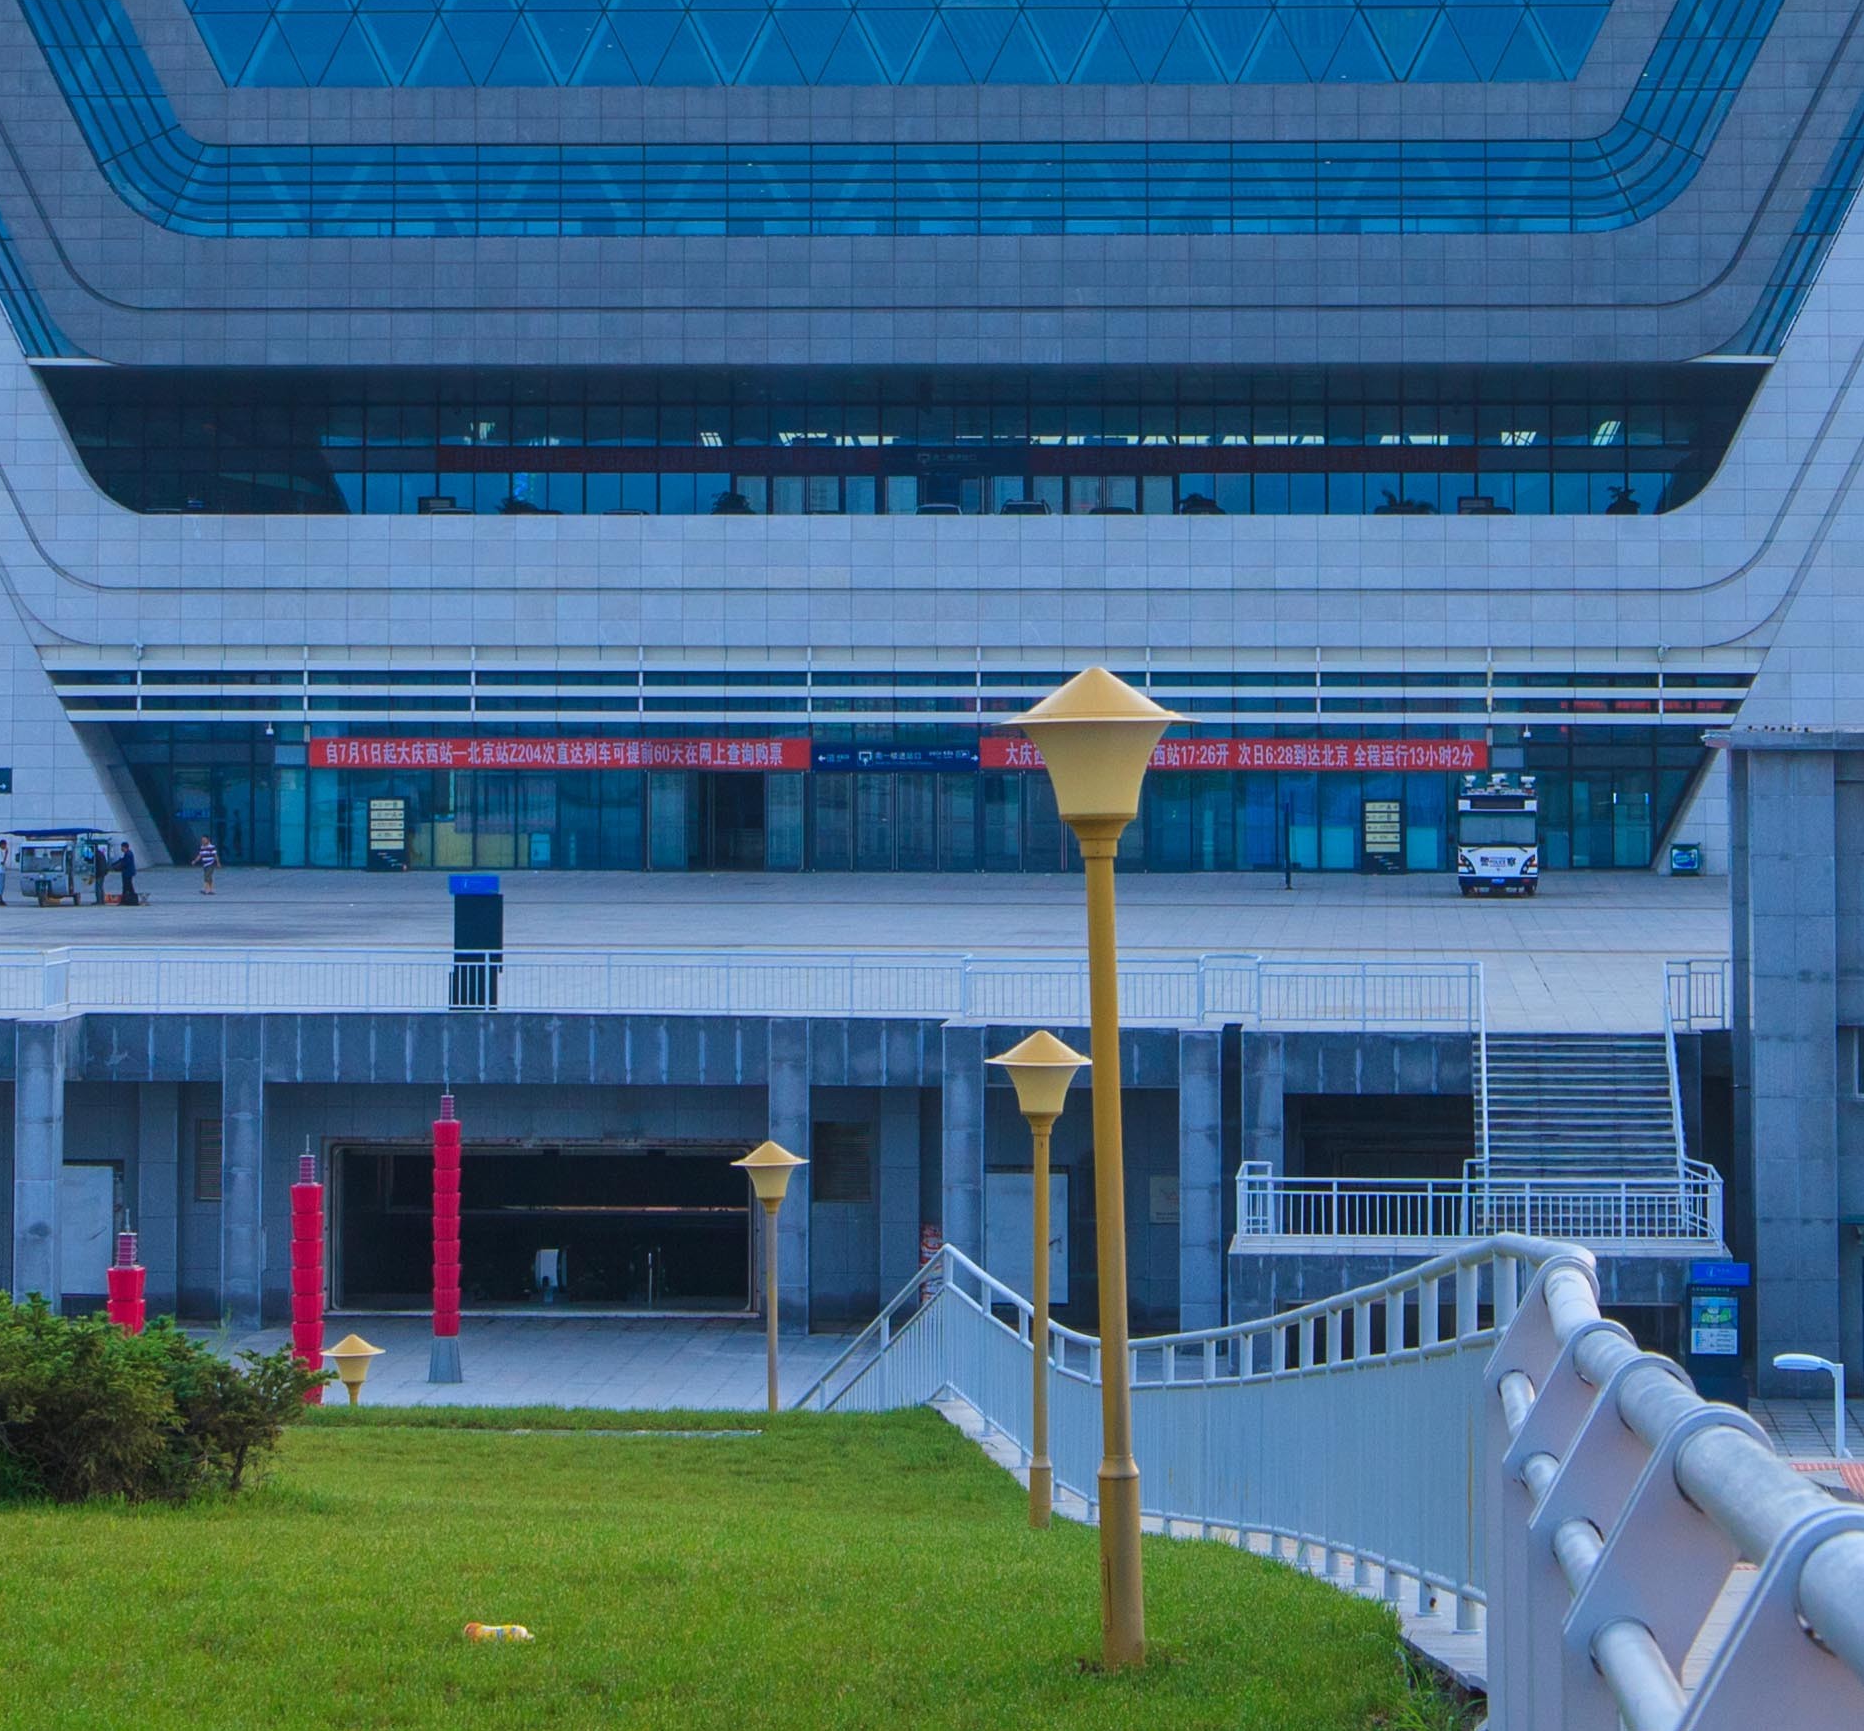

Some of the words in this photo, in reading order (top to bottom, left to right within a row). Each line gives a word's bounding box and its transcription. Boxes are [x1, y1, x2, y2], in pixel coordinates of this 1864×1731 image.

[1148, 743, 1229, 766] 西站17:26开
[1238, 743, 1349, 766] 次日6:28到达北京
[1353, 744, 1475, 767] 全程运行13小时2分
